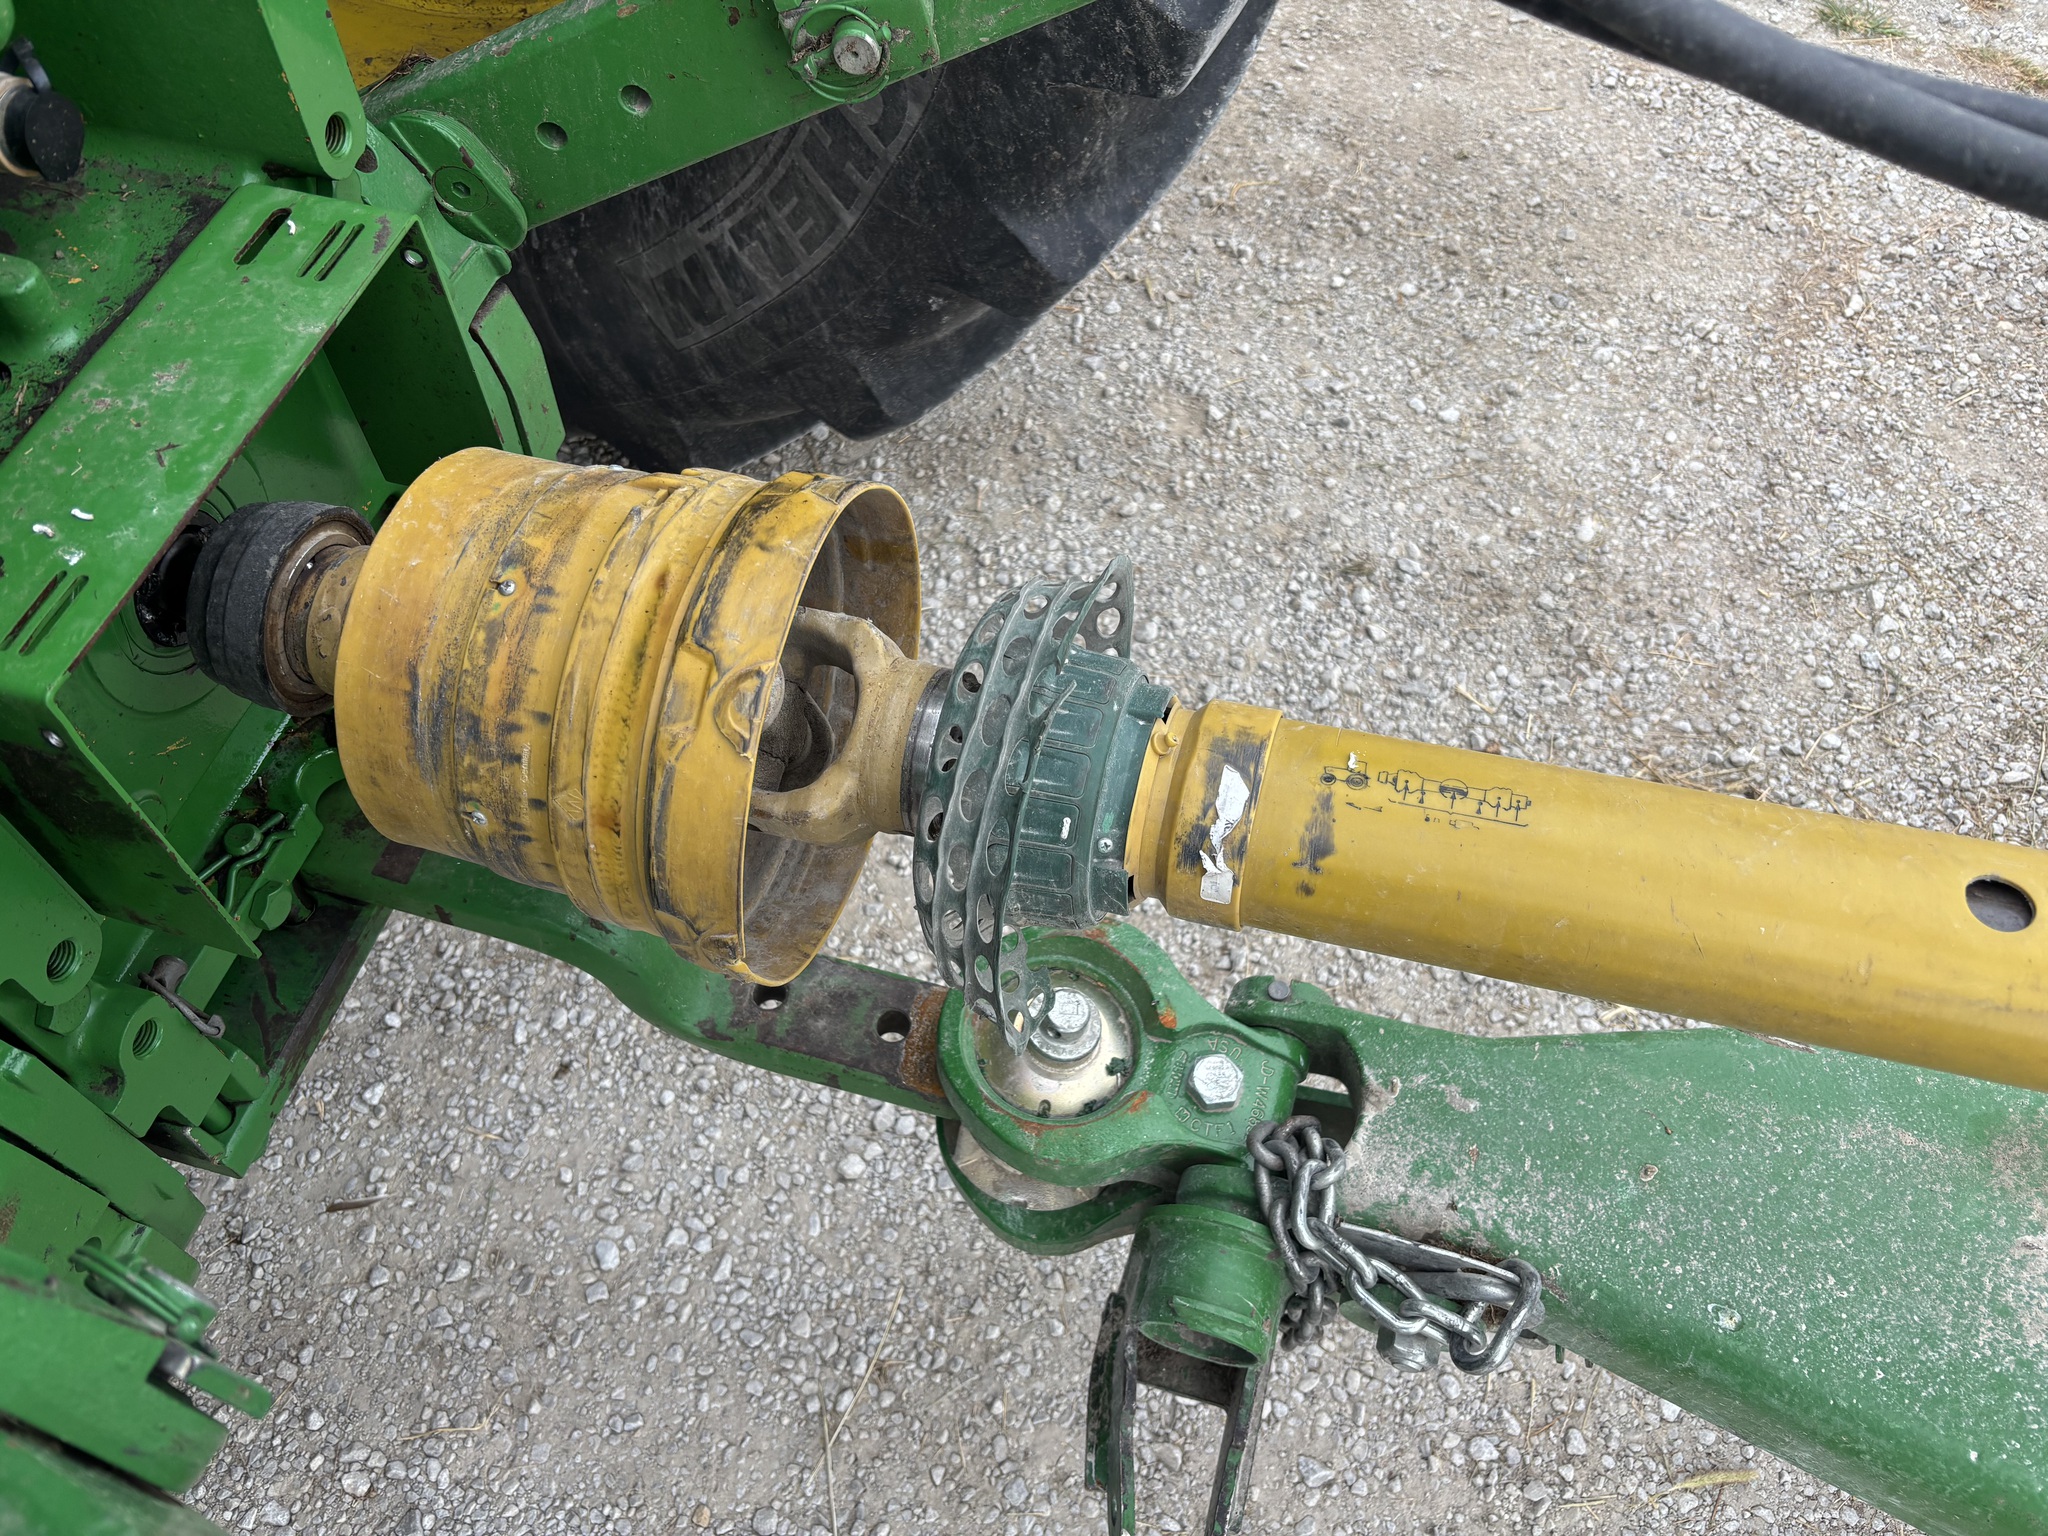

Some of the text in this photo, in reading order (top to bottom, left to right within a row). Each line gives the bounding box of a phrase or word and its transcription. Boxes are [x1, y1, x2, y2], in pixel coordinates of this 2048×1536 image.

[650, 73, 924, 339] CHELIN
[1207, 1038, 1242, 1060] USA
[1245, 1060, 1275, 1137] JD-W468
